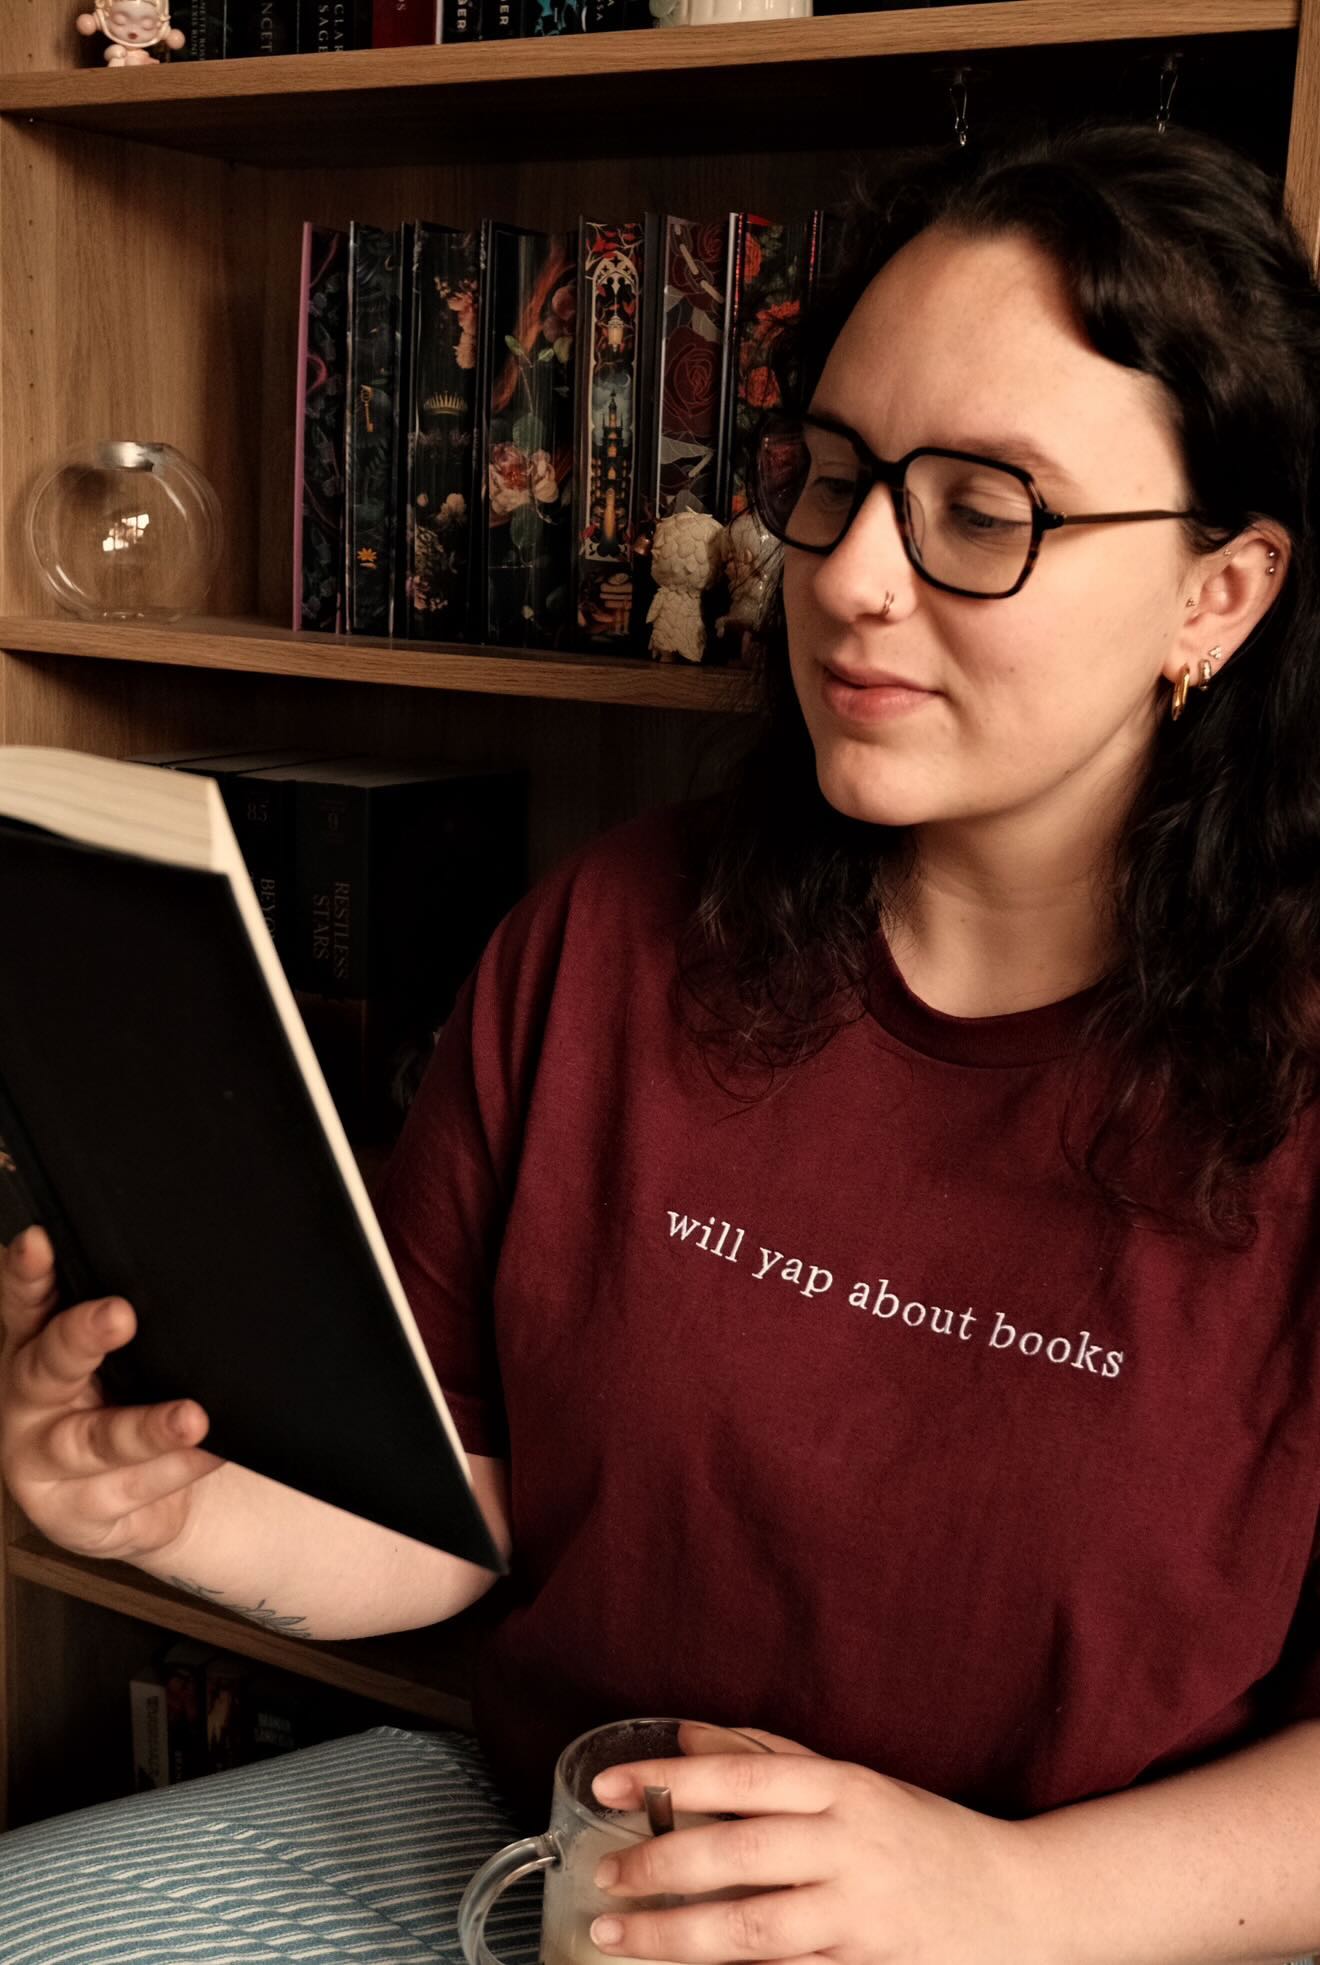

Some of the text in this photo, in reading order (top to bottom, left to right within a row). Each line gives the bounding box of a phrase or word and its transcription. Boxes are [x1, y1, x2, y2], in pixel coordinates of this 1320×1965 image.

[313, 893, 330, 960] STARS
[334, 880, 350, 984] RESTLESS
[667, 1210, 1123, 1378] will yap about books
